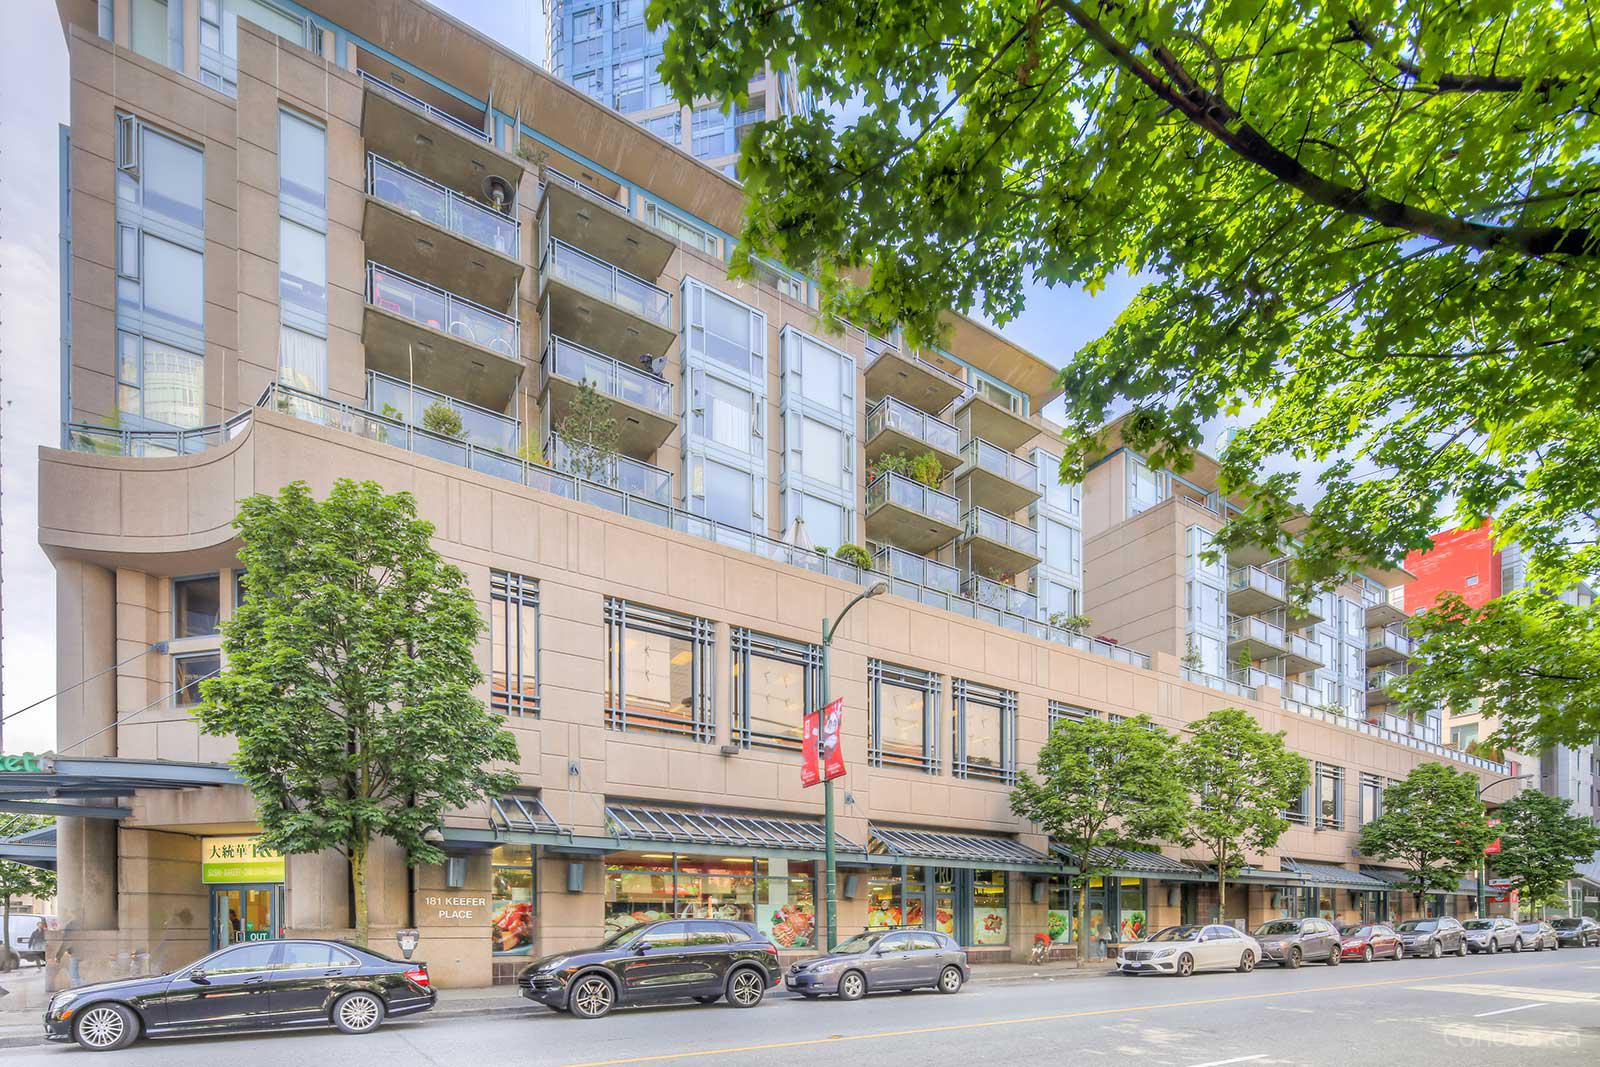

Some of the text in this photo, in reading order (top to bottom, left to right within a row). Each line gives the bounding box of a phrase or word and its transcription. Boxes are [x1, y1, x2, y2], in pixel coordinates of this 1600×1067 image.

[209, 844, 247, 859] 大統華
[425, 896, 486, 906] 181 KEEFER
[438, 910, 473, 919] PLACE
[250, 932, 268, 941] OUT
